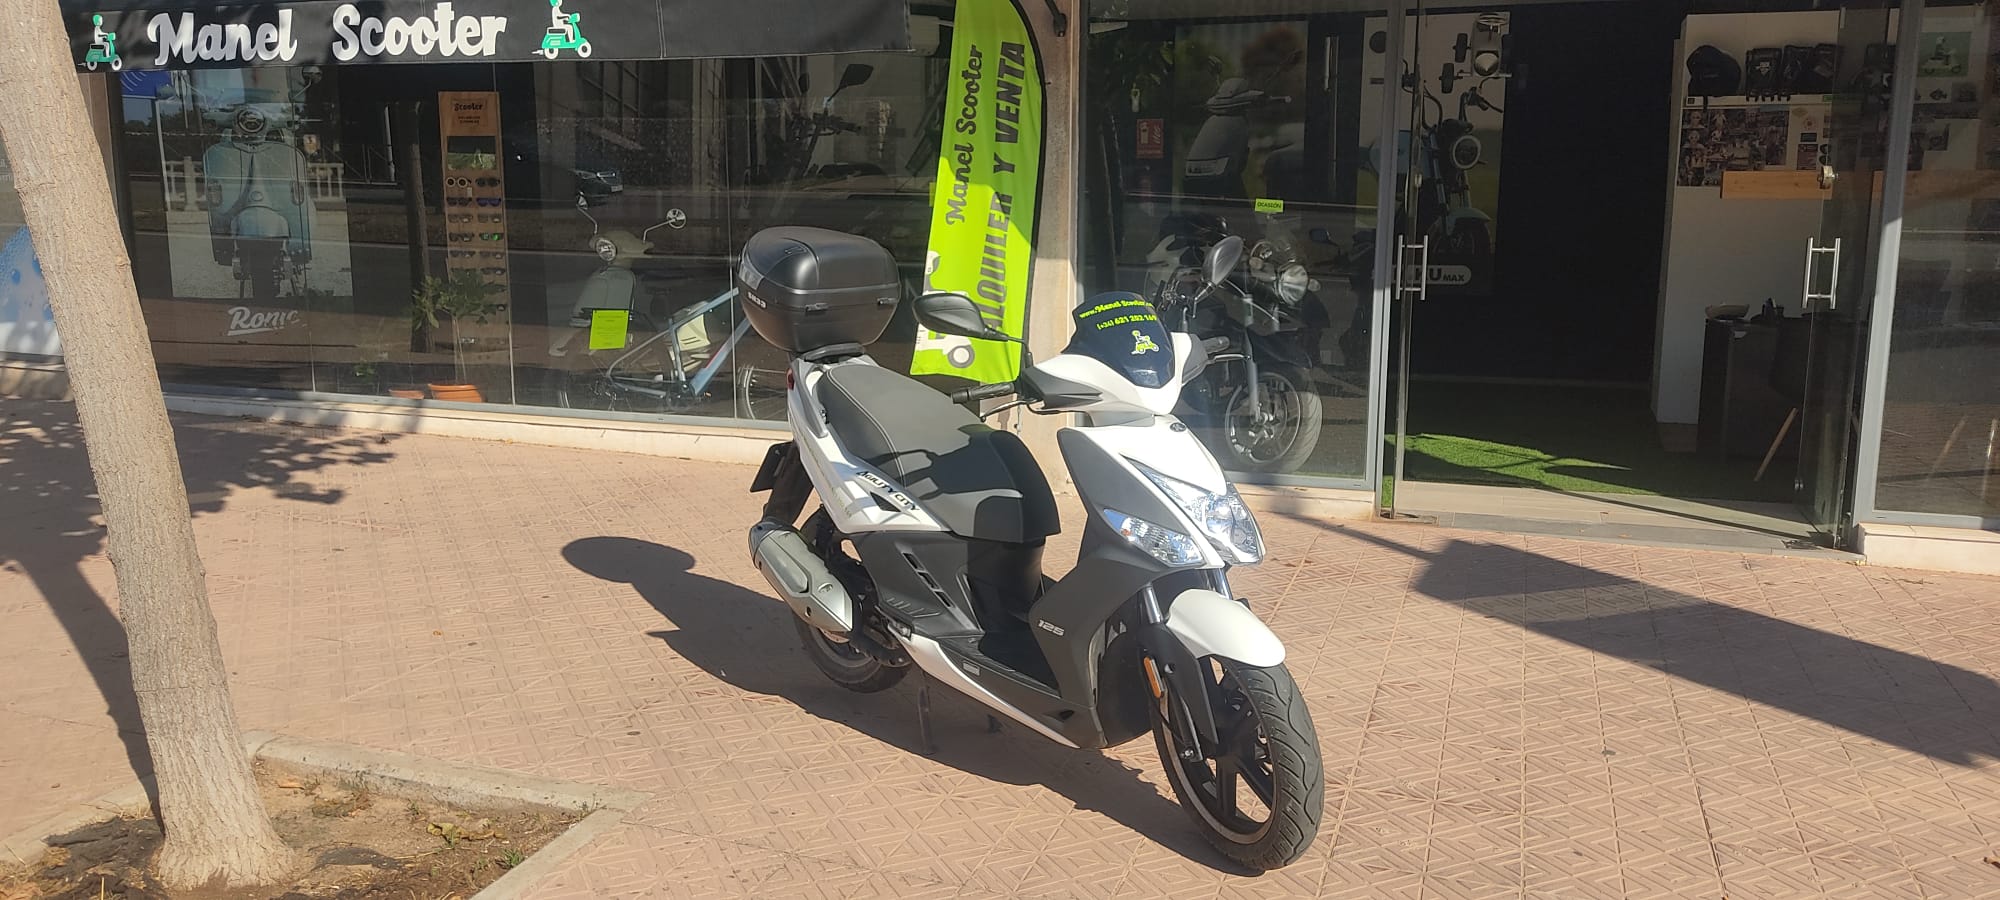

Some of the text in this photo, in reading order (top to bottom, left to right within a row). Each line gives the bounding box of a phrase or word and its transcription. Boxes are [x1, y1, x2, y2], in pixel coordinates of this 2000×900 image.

[147, 2, 508, 65] Manel Scooter
[994, 41, 1025, 144] VENTA
[945, 44, 983, 225] Manel Scooter
[992, 152, 1016, 174] Y
[1443, 273, 1465, 281] MAX
[855, 470, 920, 511] AGILITY CITY
[1038, 619, 1065, 636] 125
